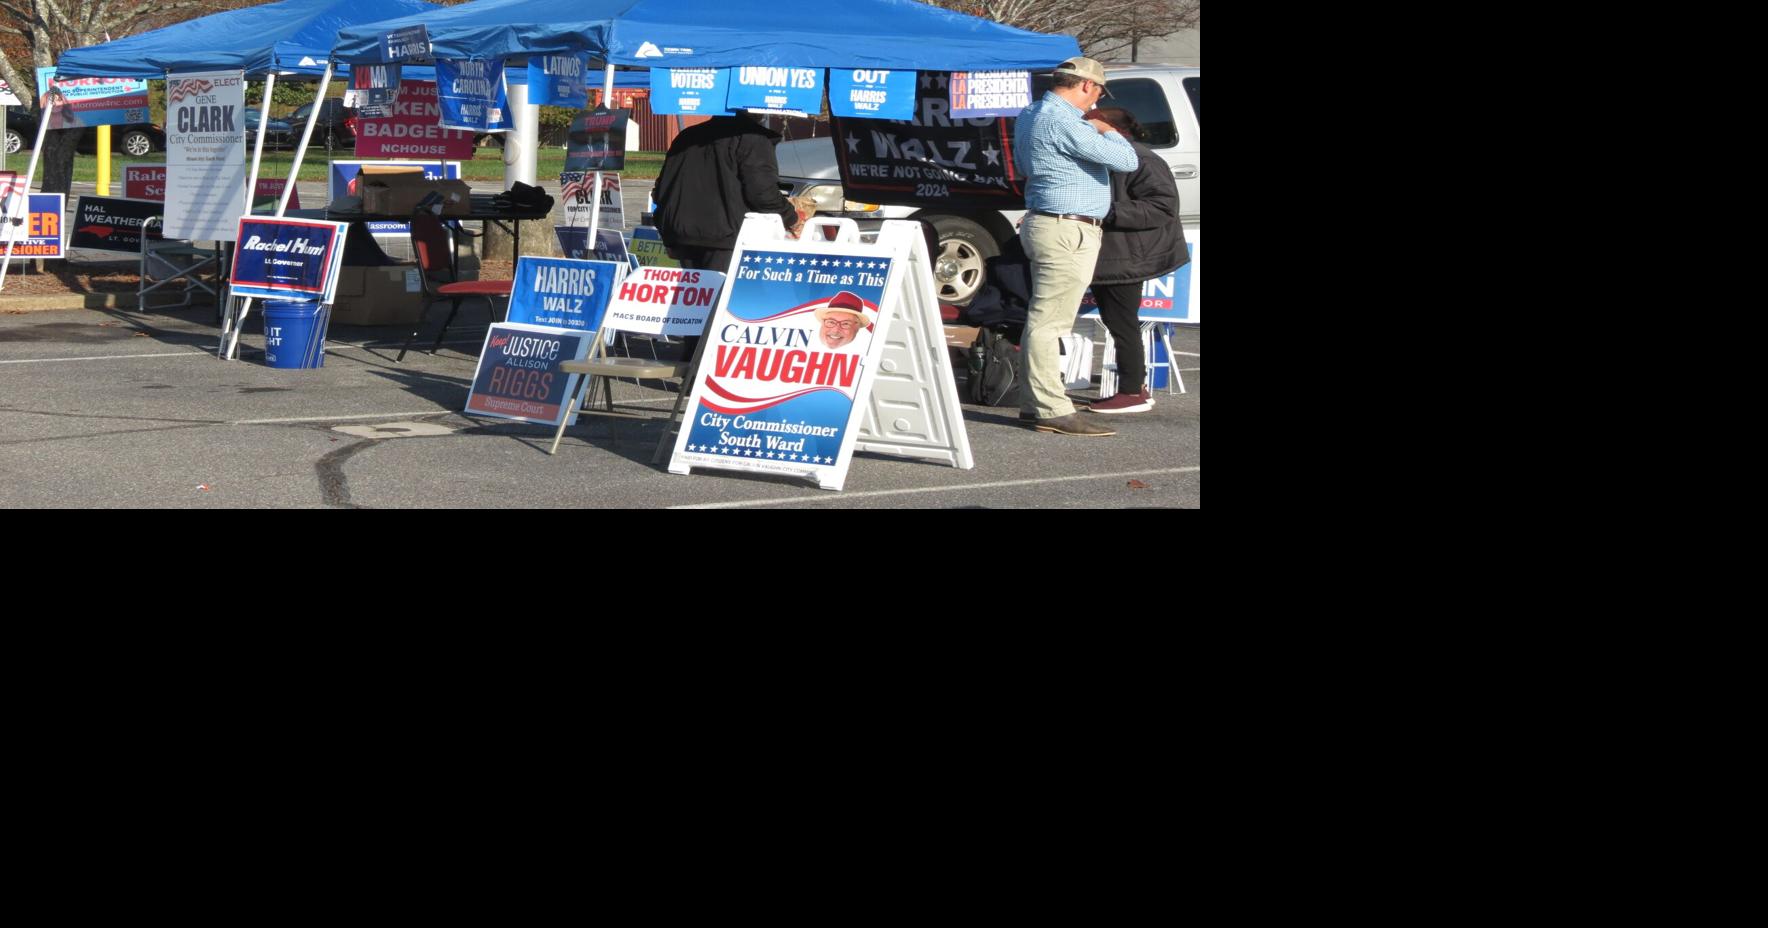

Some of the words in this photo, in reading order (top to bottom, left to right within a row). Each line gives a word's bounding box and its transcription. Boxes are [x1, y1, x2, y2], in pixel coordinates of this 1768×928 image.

[388, 42, 426, 58] HARRIS
[460, 61, 484, 78] NORTH
[544, 56, 581, 77] LATINOS
[214, 78, 240, 86] ELECT
[671, 73, 715, 90] VOTERS
[739, 67, 788, 87] UNION
[791, 69, 816, 89] YES
[852, 70, 890, 84] OUT
[412, 87, 438, 96] JUS
[453, 78, 491, 96] CAROLINA
[952, 80, 967, 94] LA
[968, 79, 1028, 94] PRESIDENTA
[196, 94, 216, 104] GENE
[850, 90, 886, 104] HARRIS
[952, 94, 967, 109] LA
[968, 94, 1029, 109] PRESIDENTA
[394, 102, 438, 116] KEN
[854, 102, 880, 111] WALZ
[178, 105, 234, 133] CLARK
[169, 134, 186, 144] City
[188, 134, 242, 144] Commissioner
[364, 123, 464, 140] BADGETT
[381, 144, 446, 154] NCHOUSE
[871, 130, 977, 170] WALZ
[850, 163, 889, 178] WE'RE
[893, 166, 921, 179] NOT
[916, 184, 950, 198] 2024
[85, 204, 106, 213] HAL
[244, 236, 293, 252] Rachel
[291, 238, 325, 256] Hunt
[273, 258, 304, 268] Governor
[534, 266, 596, 296] HARRIS
[644, 269, 700, 284] THOMAS
[738, 266, 760, 280] For
[762, 268, 792, 282] Such
[795, 273, 803, 282] a
[808, 270, 838, 284] Time
[840, 276, 854, 284] as
[858, 272, 885, 288] This
[618, 282, 714, 306] HORTON
[544, 296, 584, 313] WALZ
[613, 312, 634, 320] MACS
[636, 314, 660, 323] BOARD
[271, 328, 282, 336] IT
[720, 324, 814, 348] CALVIN
[503, 336, 560, 360] JUSTICE
[505, 358, 548, 370] ALLISON
[714, 344, 860, 388] VAUGHN
[489, 366, 552, 400] RIGGS
[484, 397, 520, 412] Supreme
[520, 402, 544, 414] Court
[700, 412, 730, 432] City
[732, 415, 838, 438] Commissioner
[718, 431, 760, 450] South
[766, 434, 804, 452] Ward
